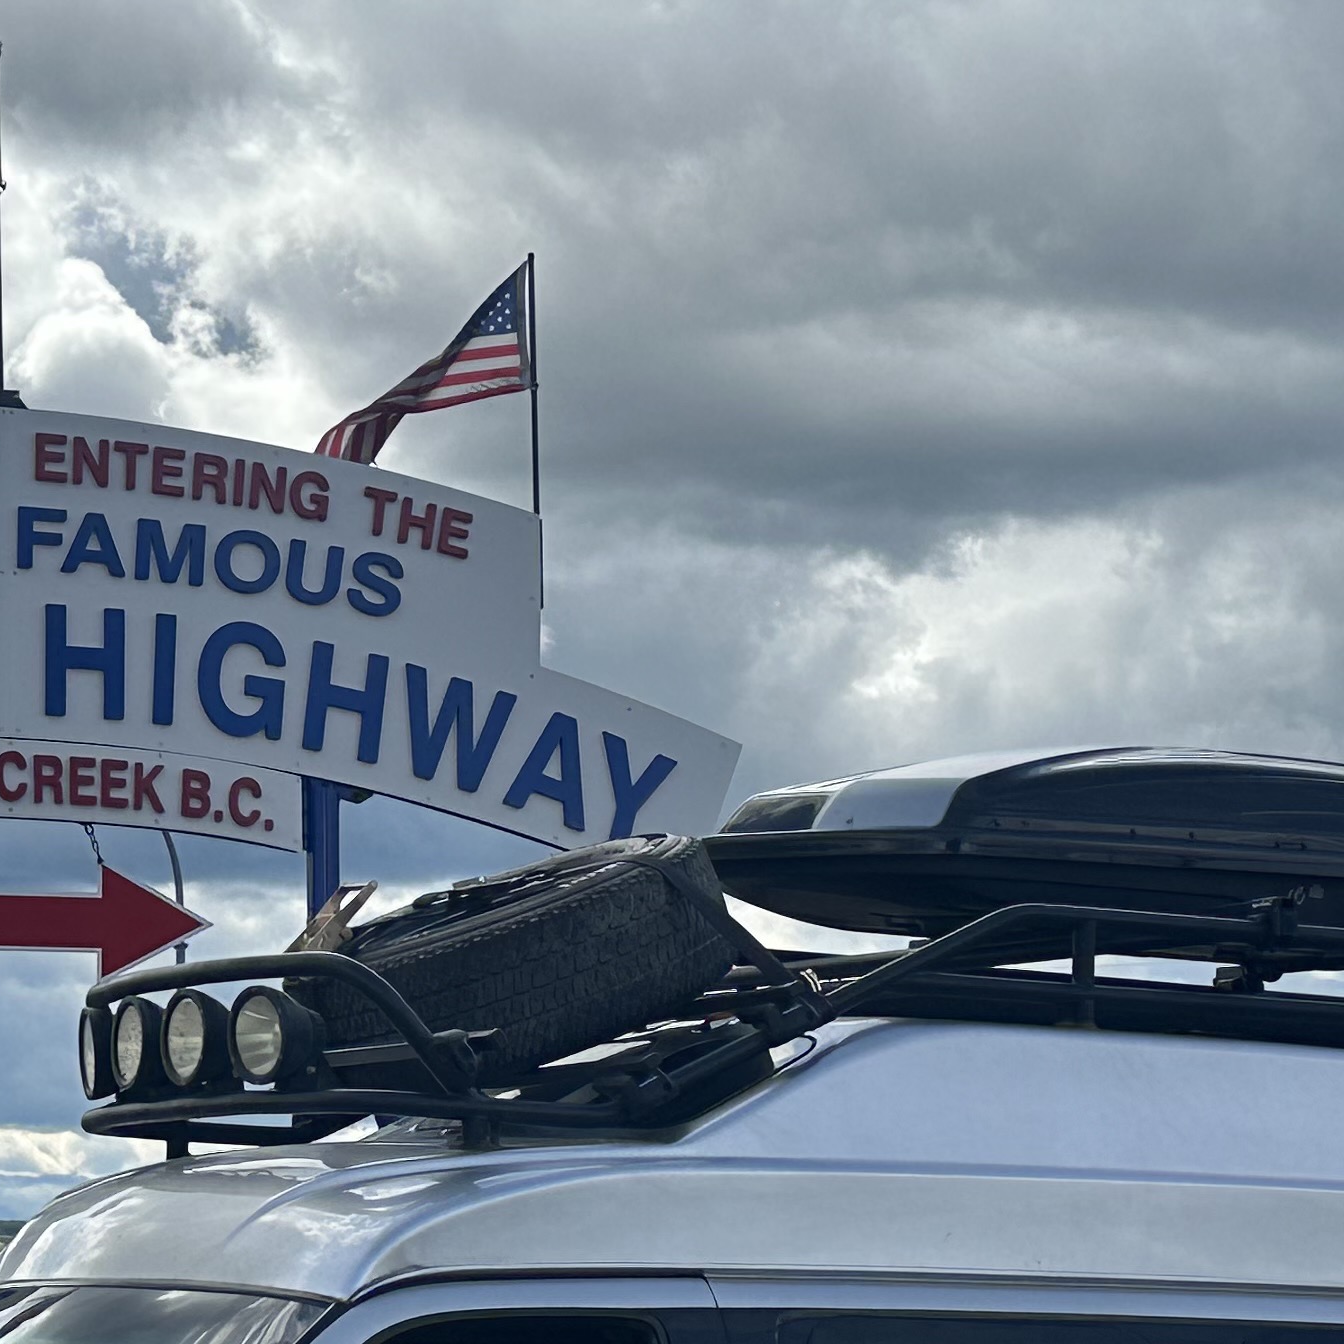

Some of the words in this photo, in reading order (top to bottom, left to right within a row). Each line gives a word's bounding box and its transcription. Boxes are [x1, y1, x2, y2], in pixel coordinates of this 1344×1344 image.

[34, 431, 330, 523] ENTERING
[364, 486, 474, 560] THE
[16, 505, 405, 617] FAMOUS
[44, 603, 678, 841] HIGHWAY
[180, 767, 276, 833] B.C.
